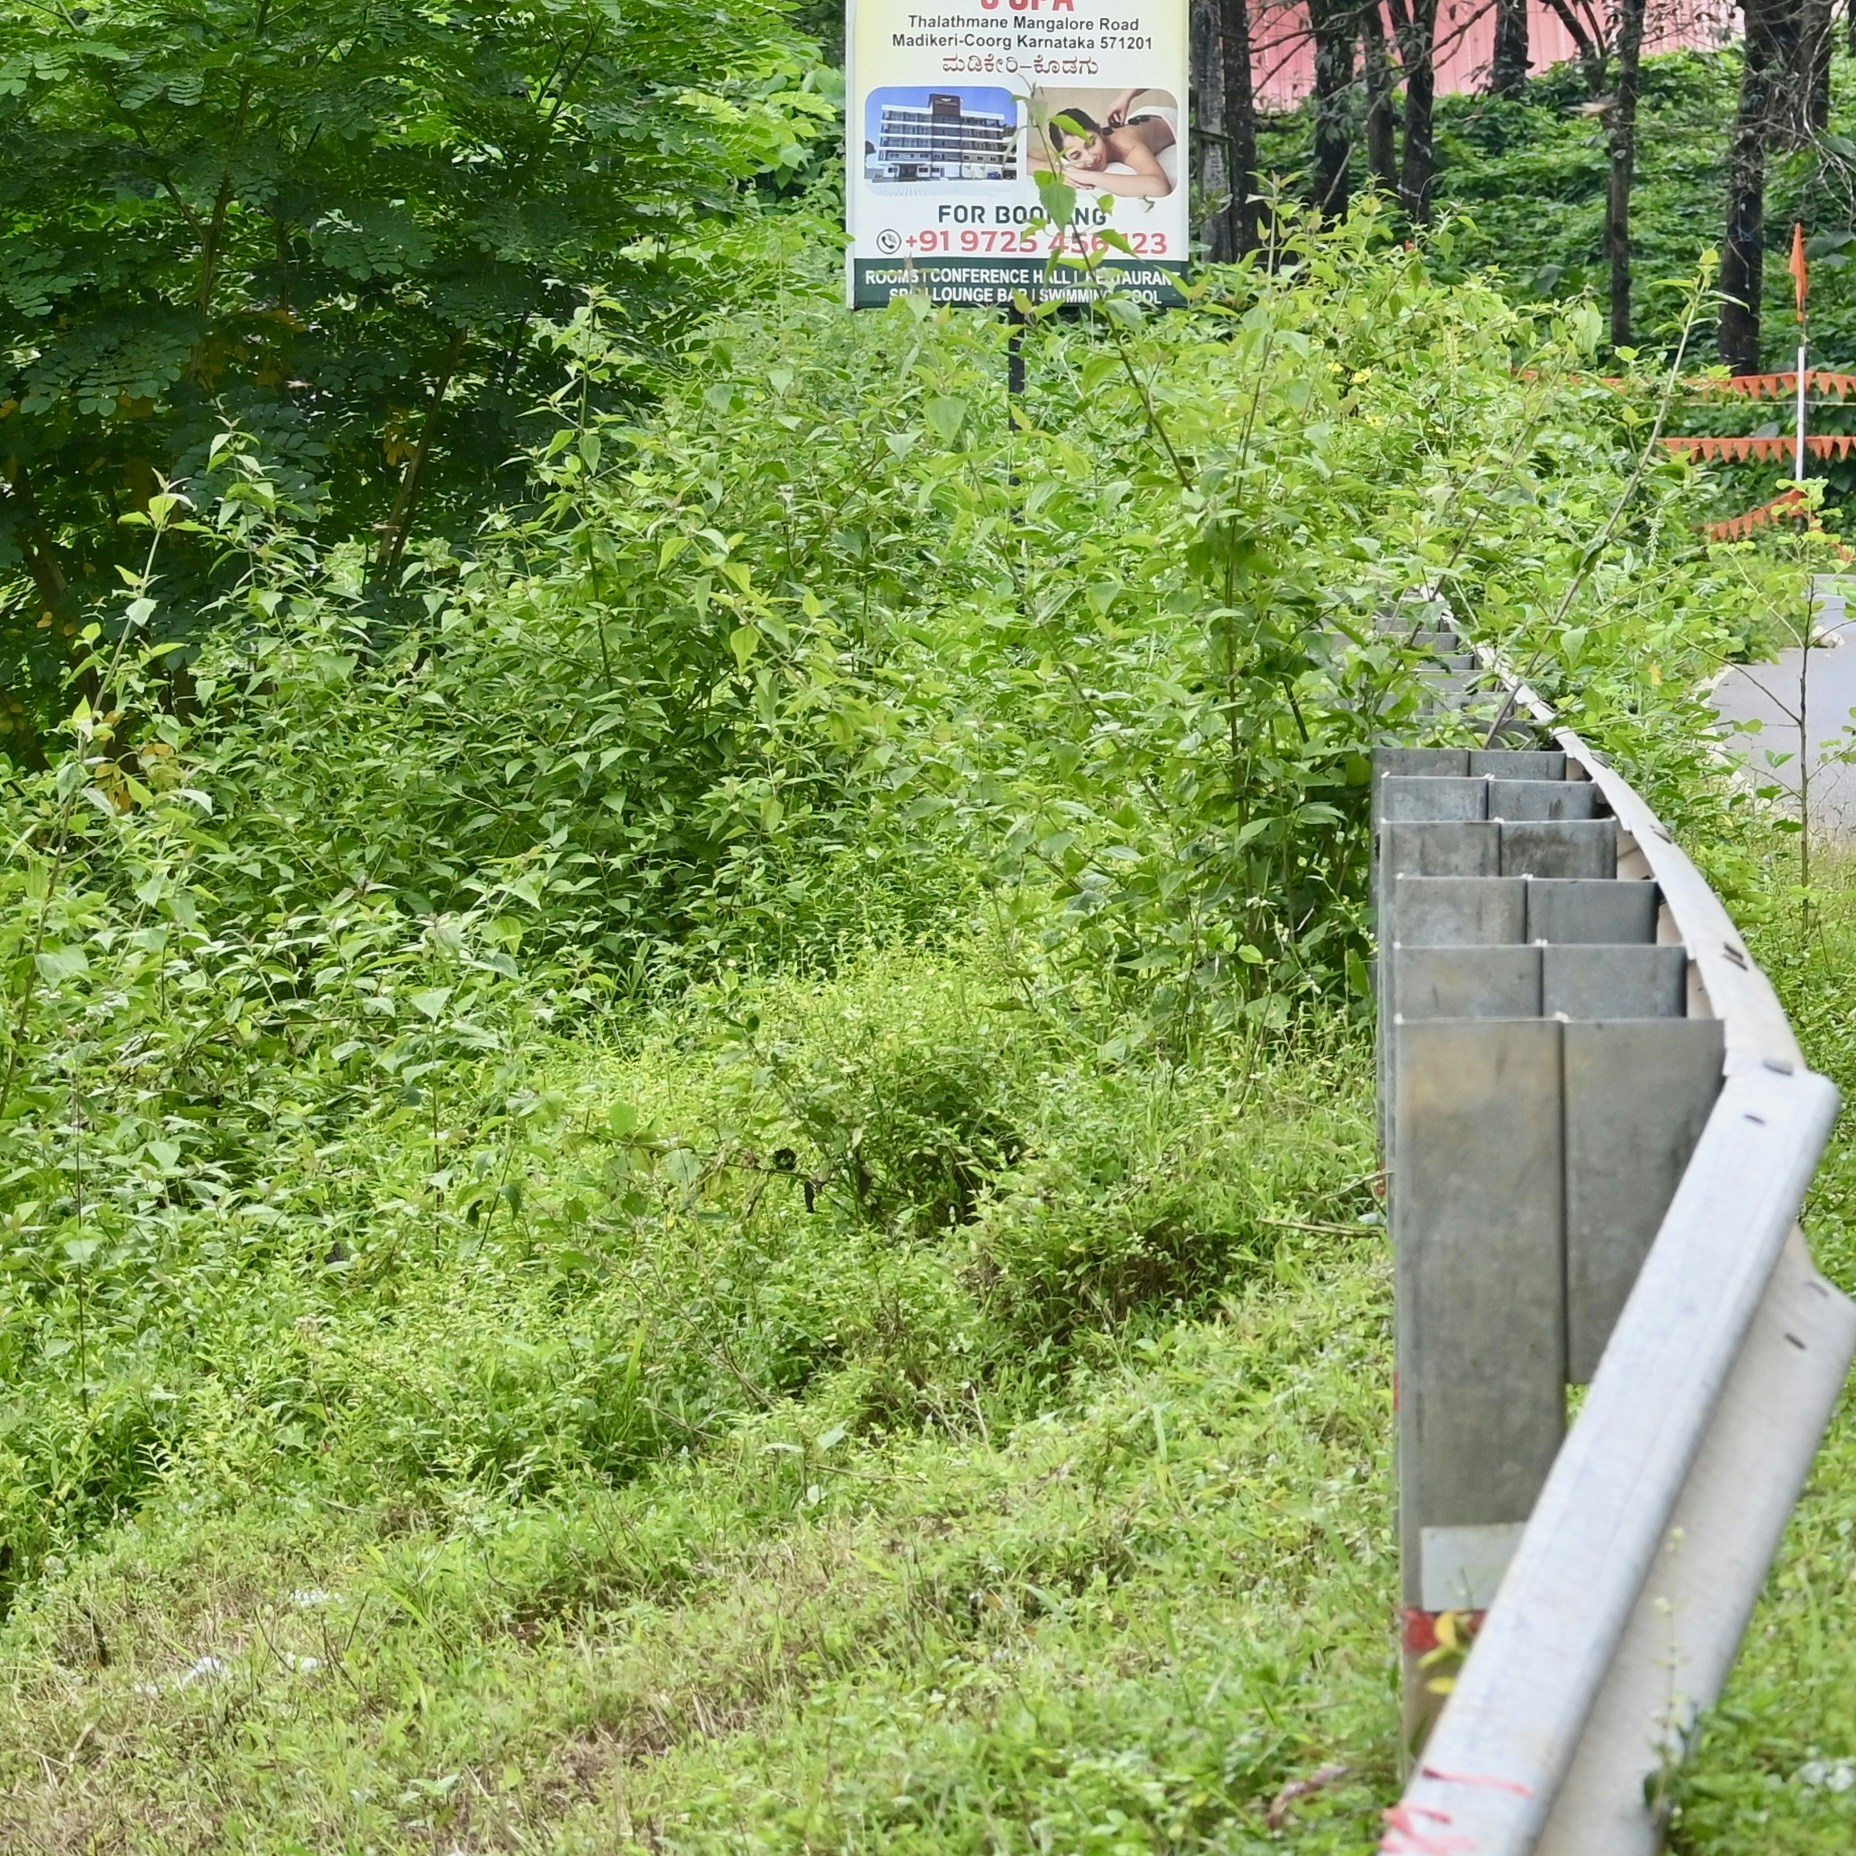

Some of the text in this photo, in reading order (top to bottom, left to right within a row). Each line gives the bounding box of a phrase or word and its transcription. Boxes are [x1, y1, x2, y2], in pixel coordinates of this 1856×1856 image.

[908, 14, 1140, 33] Thalathmane Mangalore Road
[892, 33, 1153, 50] Madikeri-Coorg Karnataka 571201
[938, 205, 1107, 225] FOR BOONG
[905, 230, 950, 252] +91
[960, 230, 1038, 253] 9725
[1048, 232, 1110, 254] 456
[865, 269, 919, 285] ROOMS
[930, 268, 1029, 284] CONFERENCE
[1033, 269, 1071, 285] HALL
[933, 287, 994, 302] LOUNGE
[1121, 289, 1162, 305] OOL
